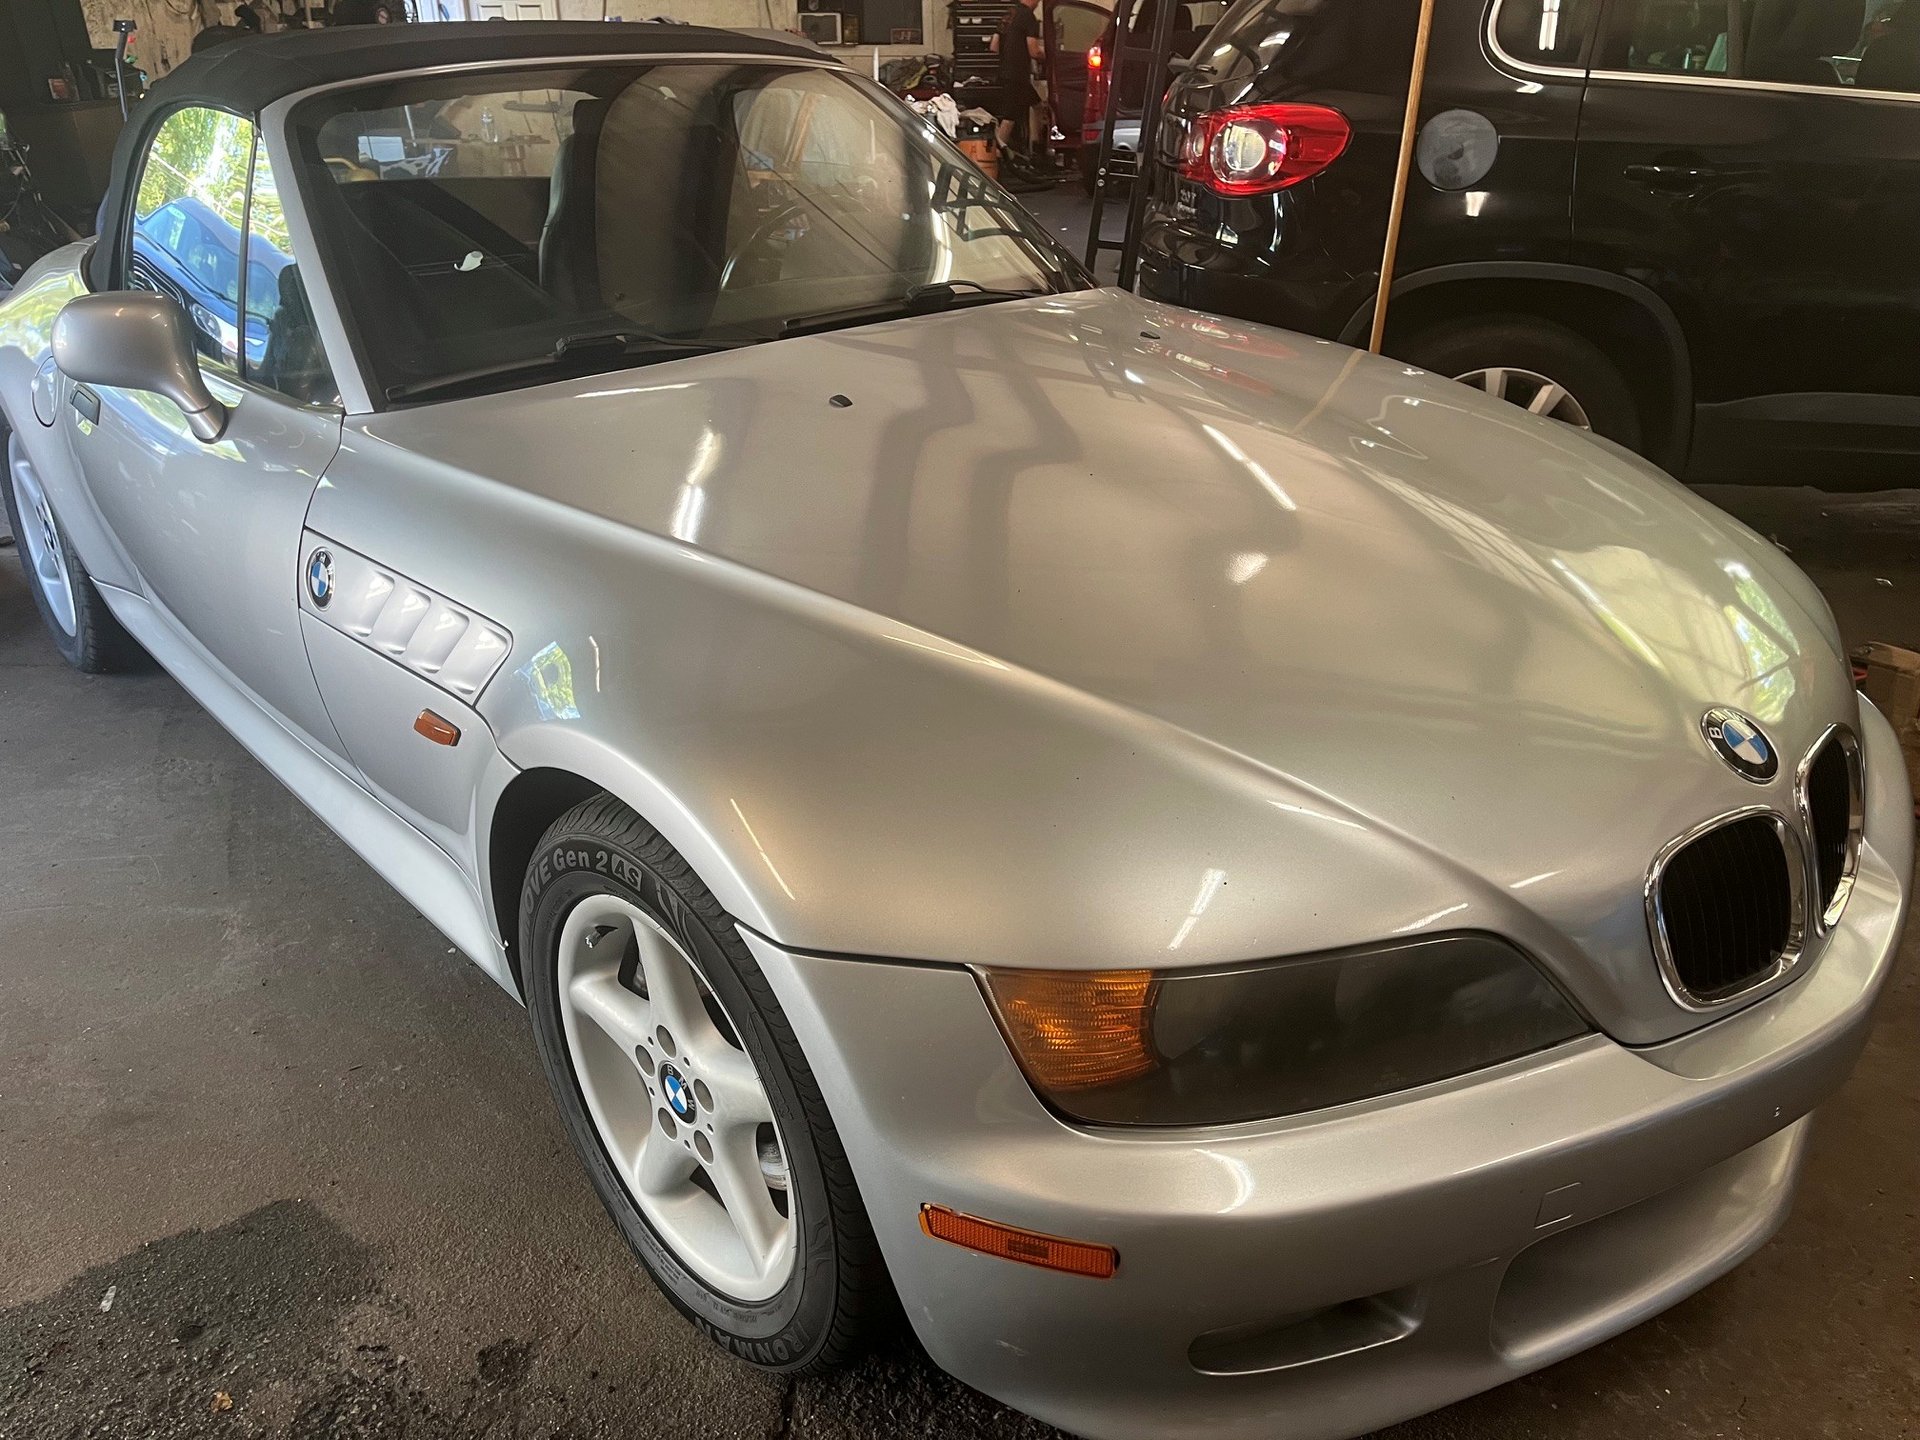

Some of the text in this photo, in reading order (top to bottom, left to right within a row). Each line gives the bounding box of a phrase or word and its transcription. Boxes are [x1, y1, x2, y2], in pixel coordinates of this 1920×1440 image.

[553, 847, 591, 869] Gen
[595, 850, 609, 873] 2
[613, 856, 640, 889] AS
[666, 1065, 696, 1111] BMW
[693, 1316, 812, 1363] IRONMAN
